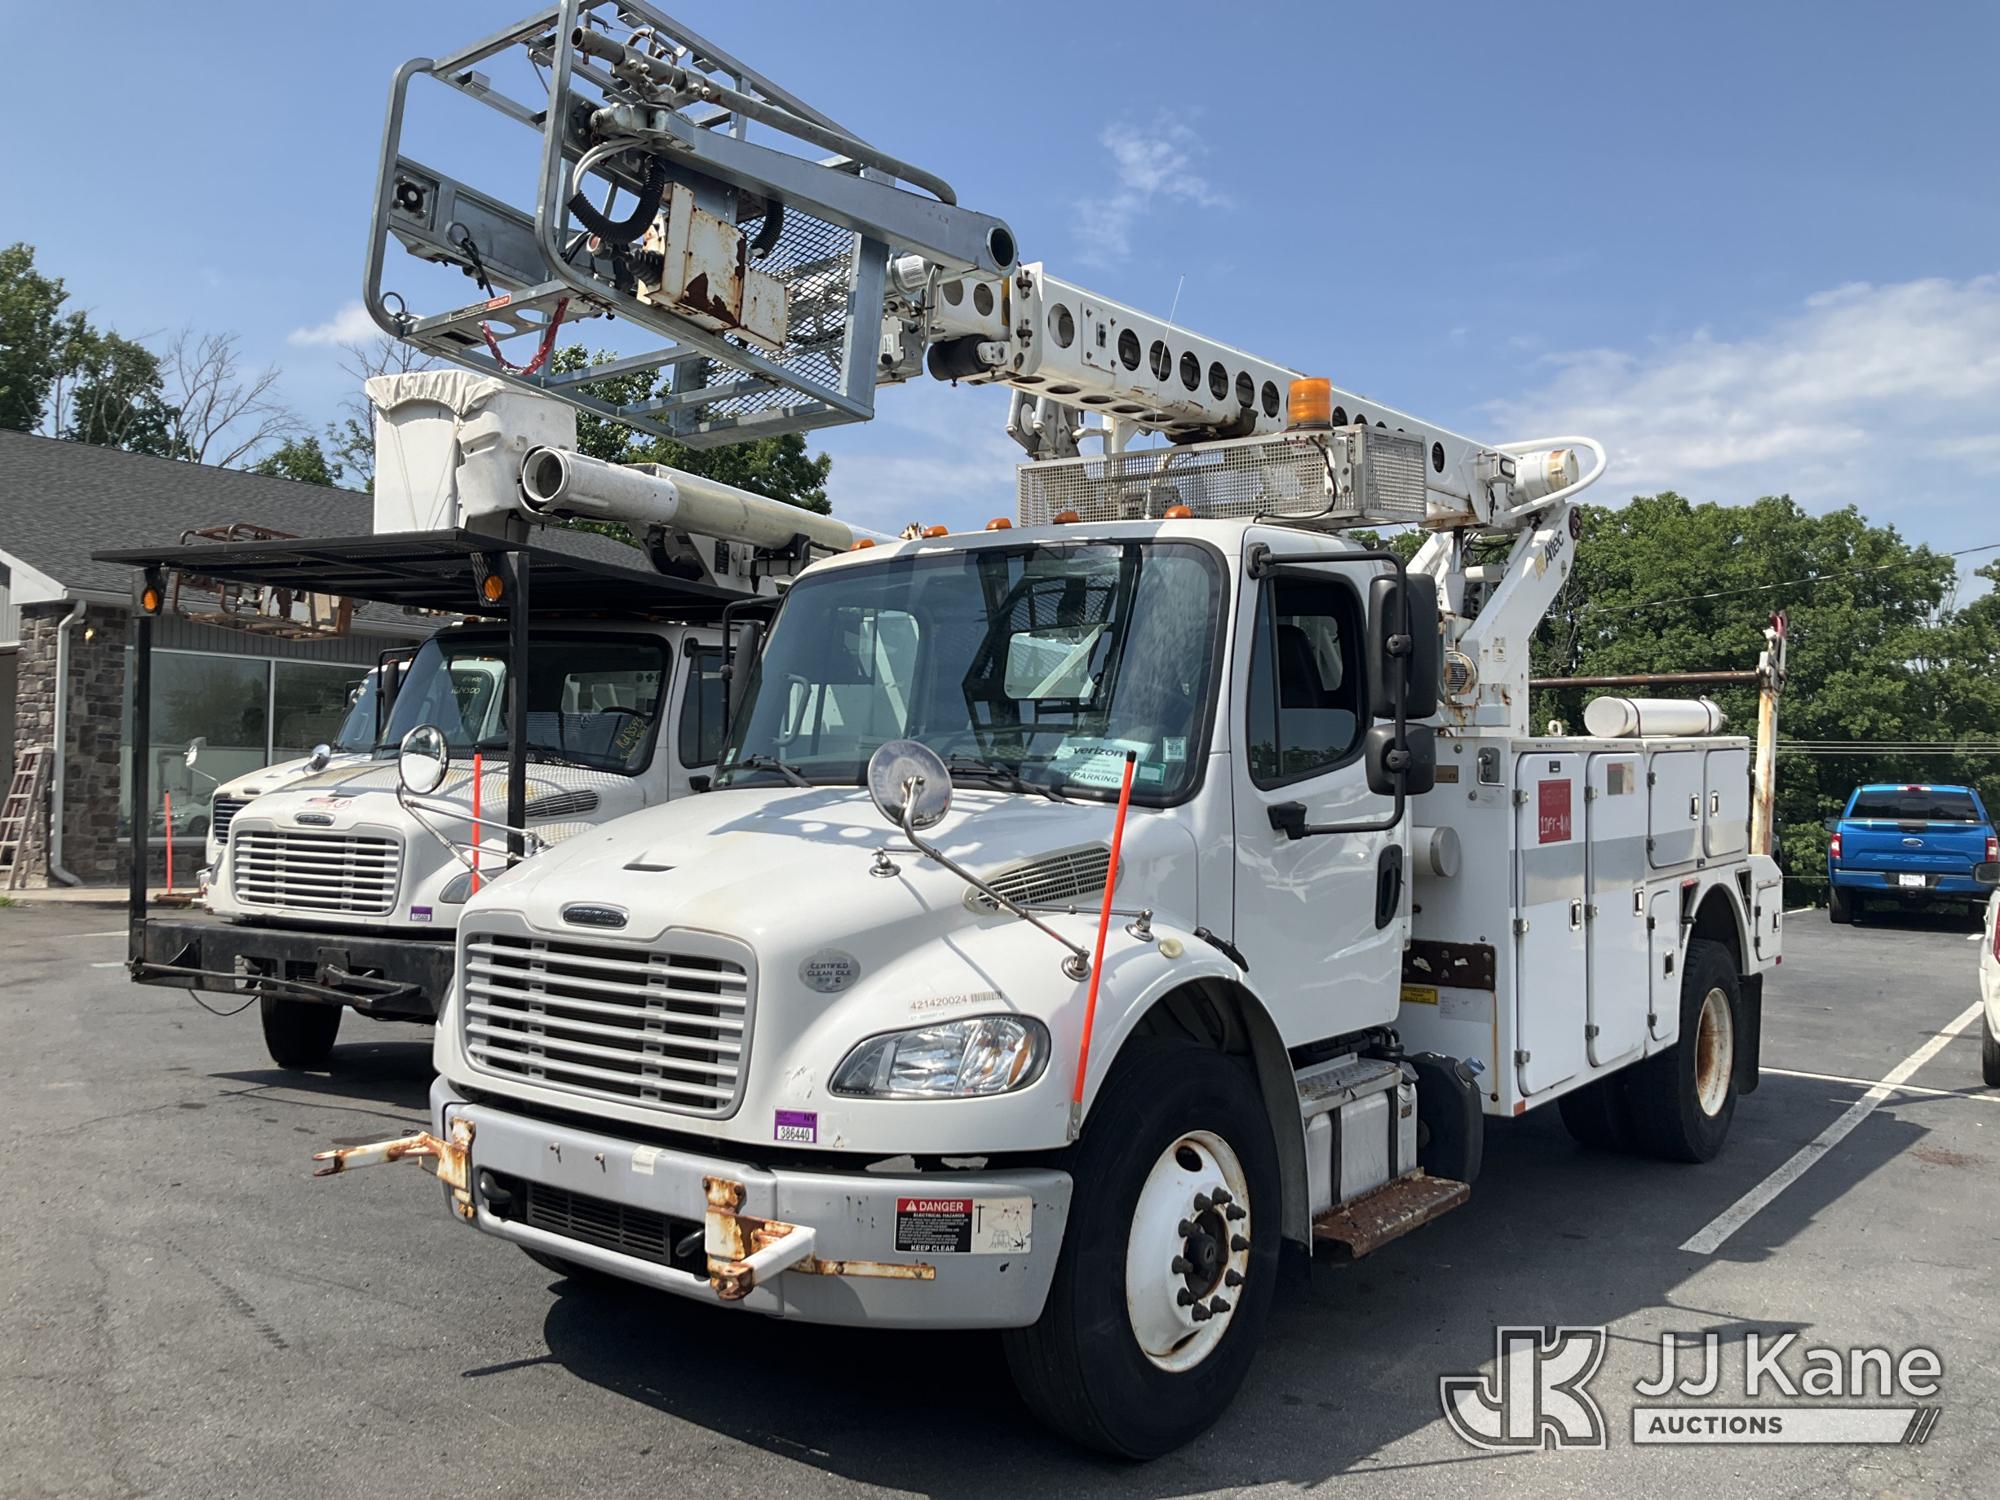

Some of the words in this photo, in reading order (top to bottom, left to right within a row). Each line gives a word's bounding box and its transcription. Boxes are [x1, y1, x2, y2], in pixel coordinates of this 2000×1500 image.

[1545, 530, 1564, 569] Altec
[1073, 745, 1125, 758] verizon
[1072, 771, 1120, 784] PARKING
[911, 995, 968, 1010] 421420024
[780, 1127, 810, 1141] 386440
[919, 1201, 965, 1212] DANGER
[910, 1244, 930, 1252] KEEP
[931, 1244, 956, 1252] CLEAR
